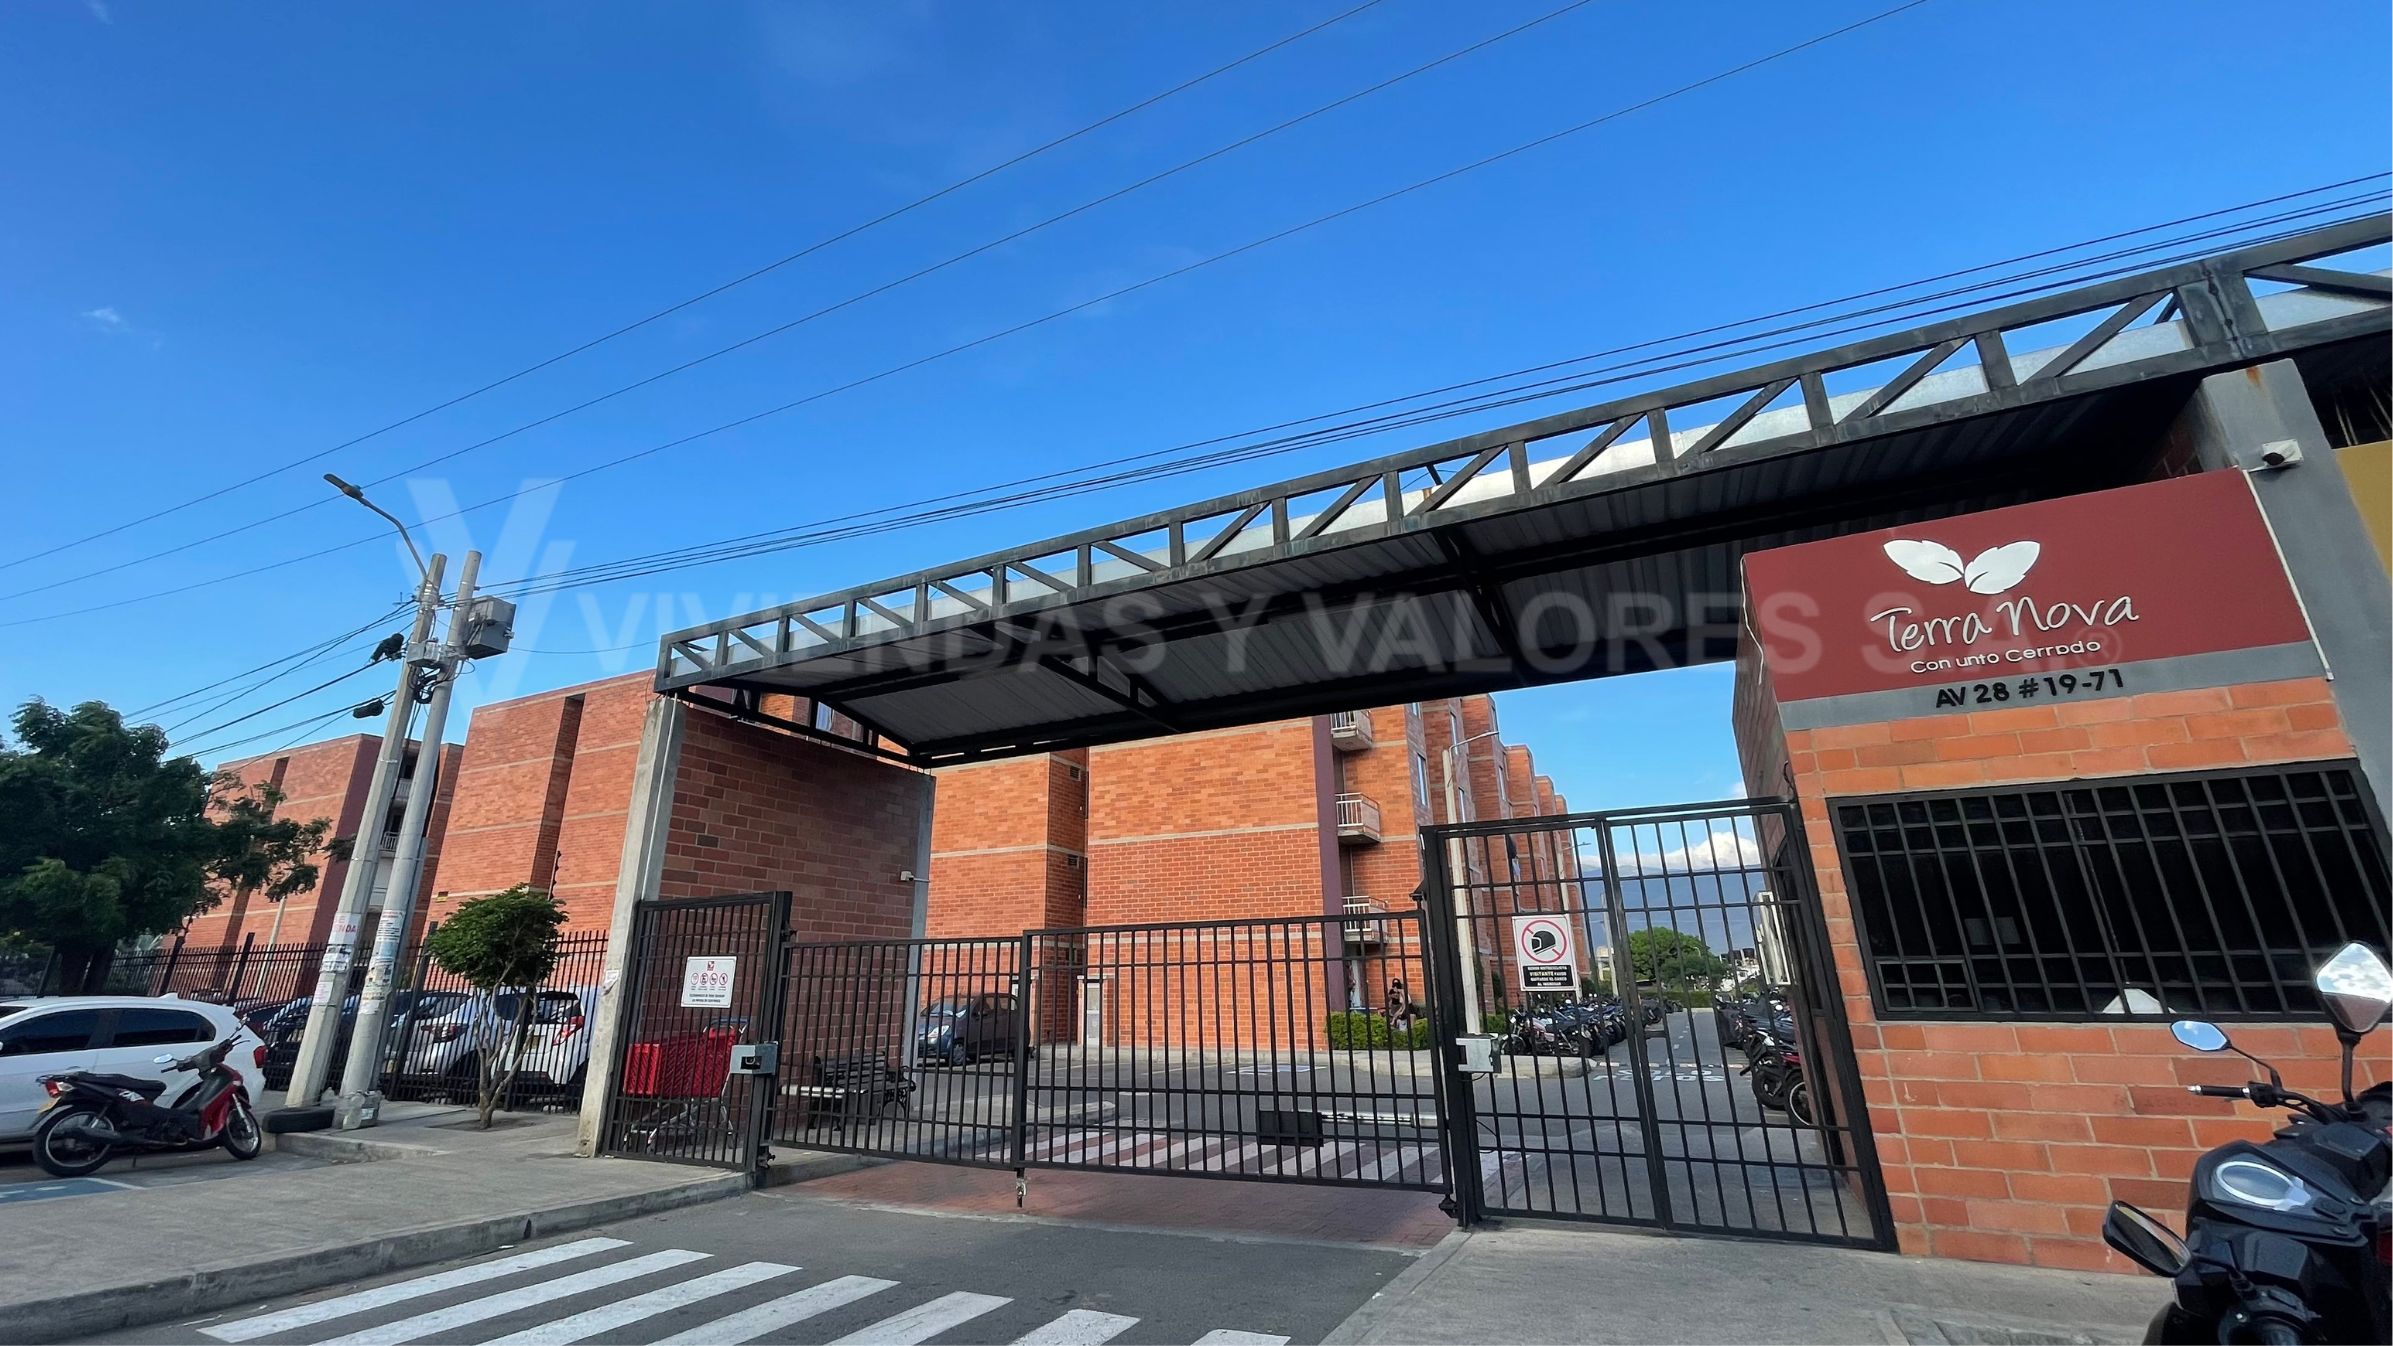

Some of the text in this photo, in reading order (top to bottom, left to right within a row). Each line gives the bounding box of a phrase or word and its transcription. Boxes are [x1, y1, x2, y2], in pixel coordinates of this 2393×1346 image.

[1870, 596, 2140, 652] Terra Nova
[1935, 687, 1966, 709] AV
[1973, 684, 2010, 704] 28
[2043, 669, 2124, 697] 19-71
